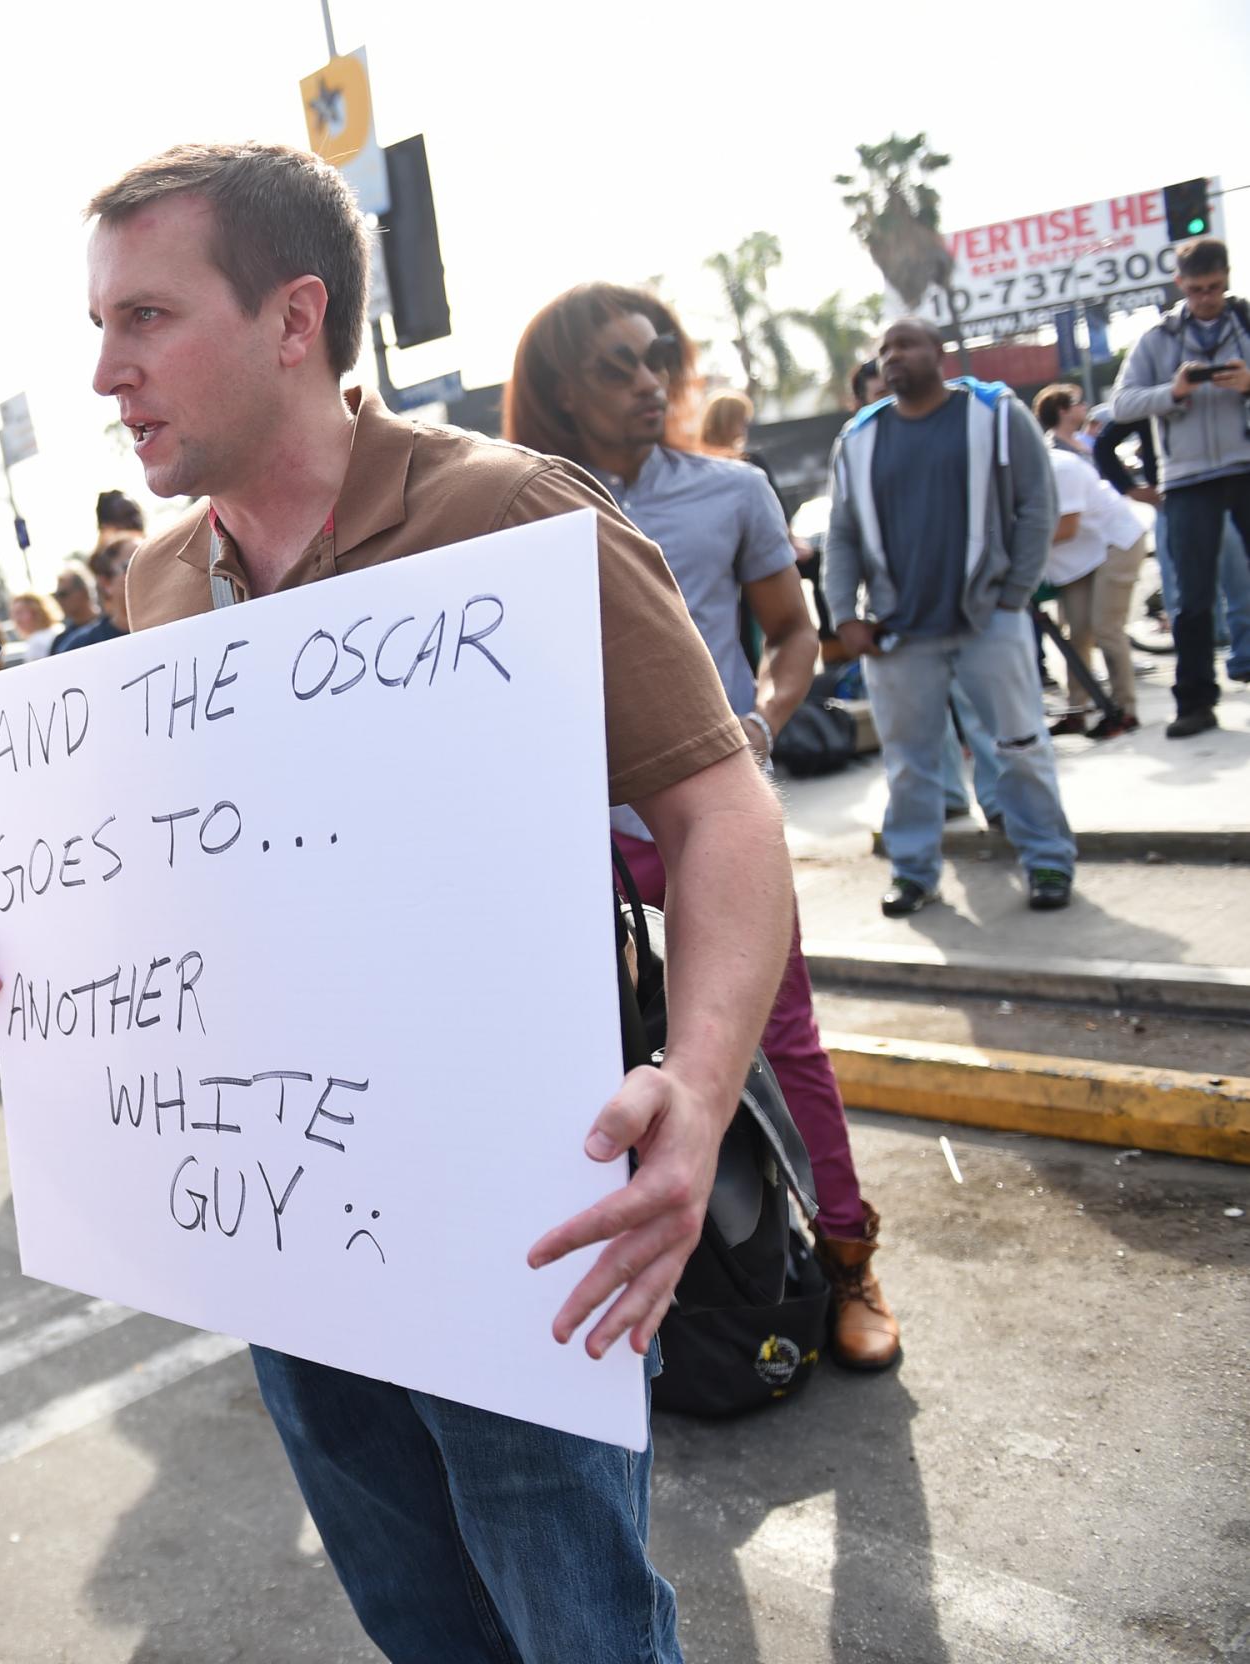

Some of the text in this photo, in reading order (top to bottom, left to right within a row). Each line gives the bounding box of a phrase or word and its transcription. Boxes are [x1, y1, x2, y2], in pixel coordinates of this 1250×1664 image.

[943, 204, 1093, 259] VERTISE
[931, 246, 1178, 317] 10-737-300
[120, 639, 250, 739] THE
[291, 594, 512, 701] OSCAR
[150, 799, 339, 869] TO...
[7, 950, 207, 1042] ANOTHER
[105, 1065, 370, 1154] WHITE
[169, 1154, 305, 1252] GUY
